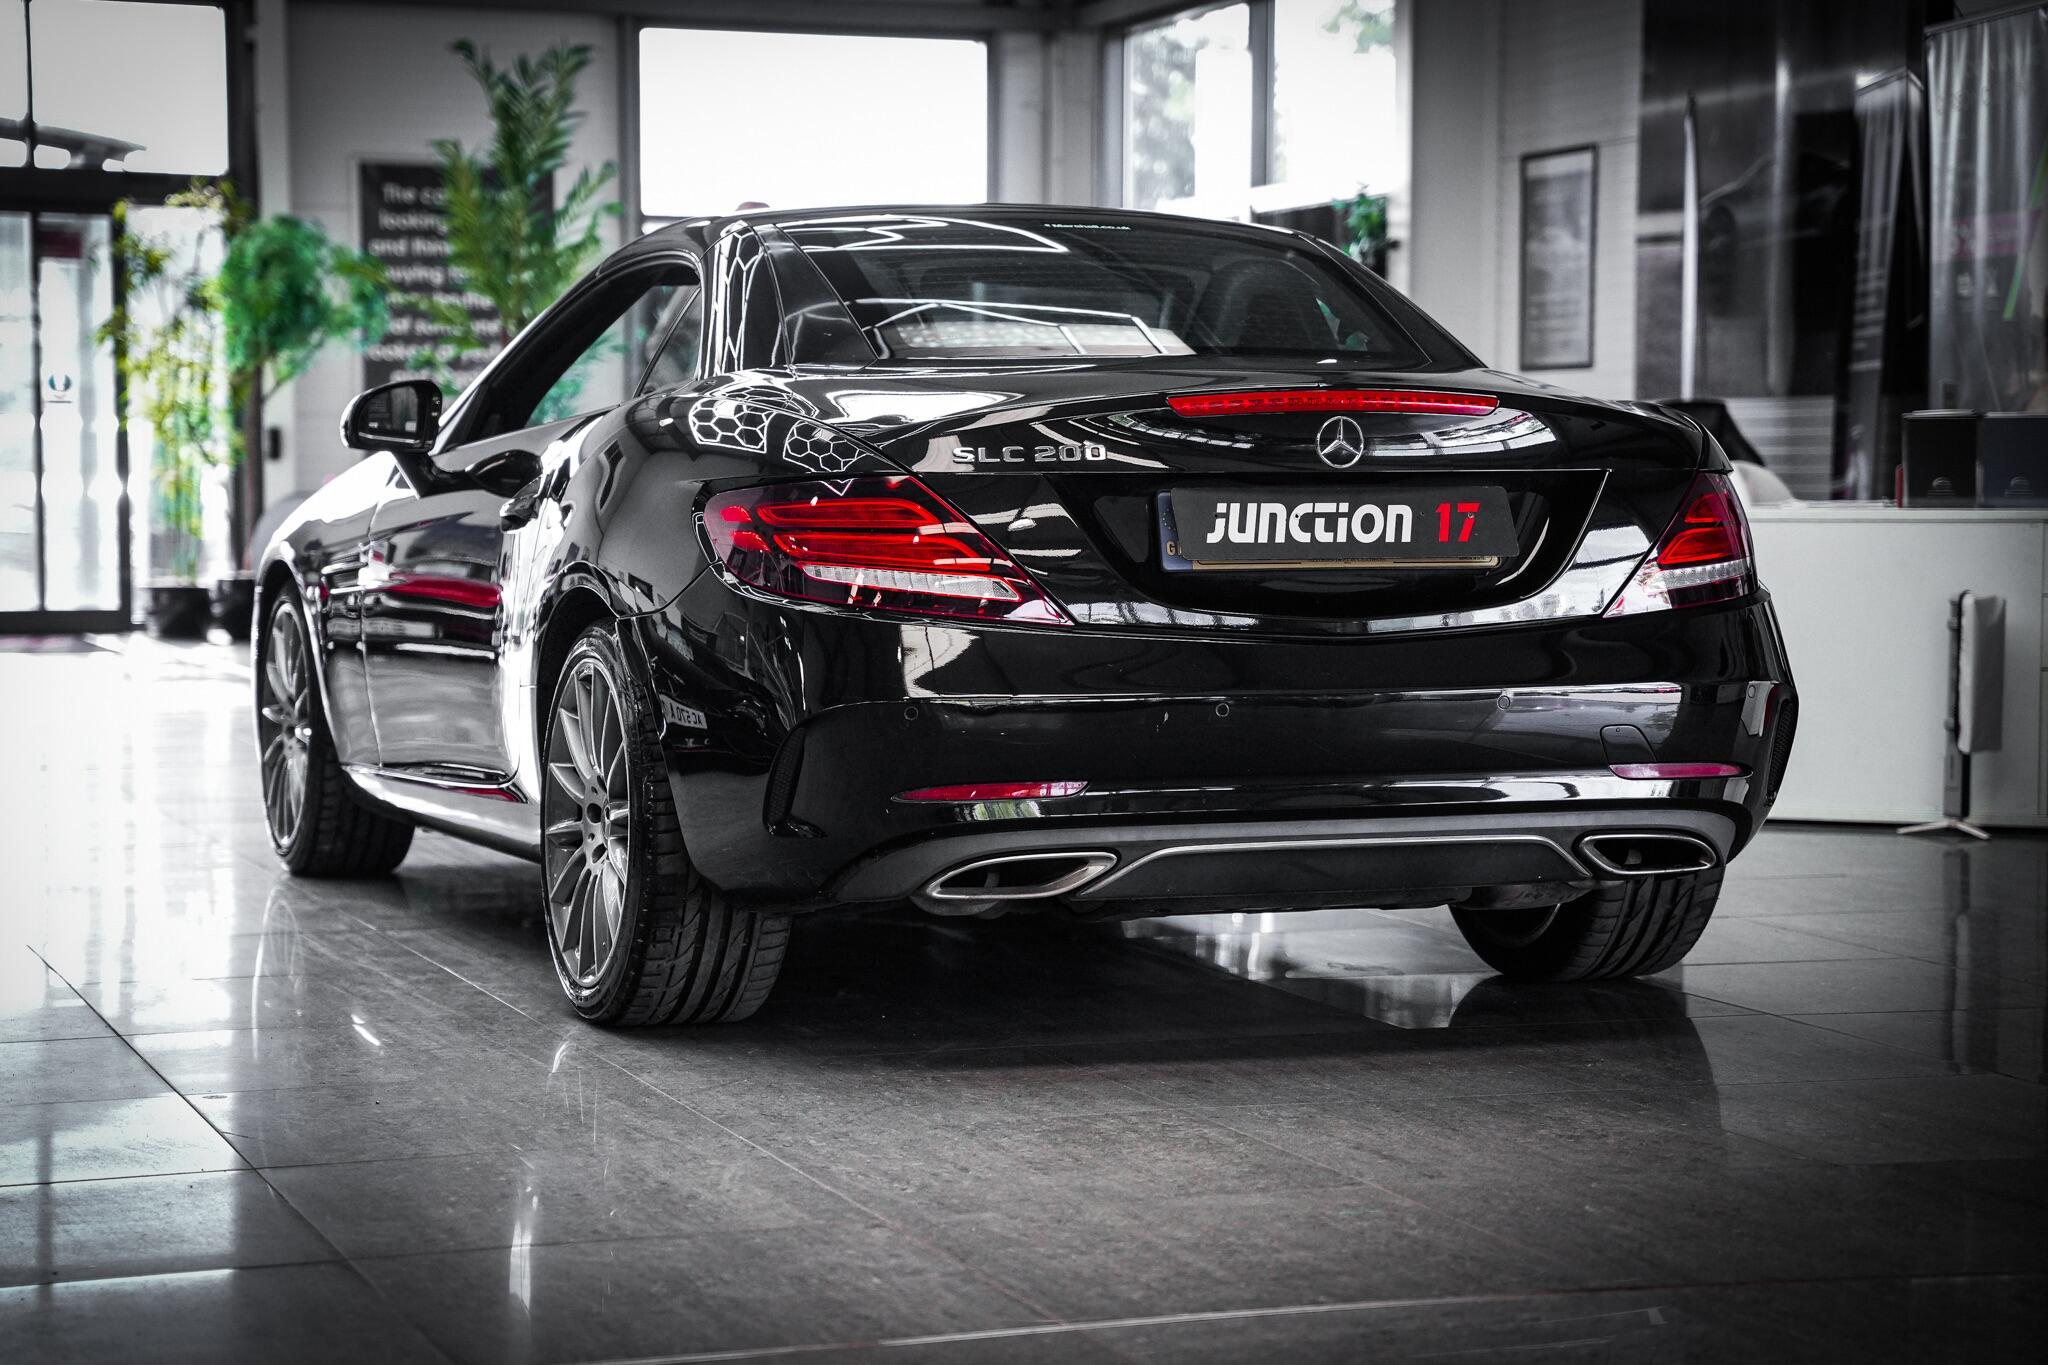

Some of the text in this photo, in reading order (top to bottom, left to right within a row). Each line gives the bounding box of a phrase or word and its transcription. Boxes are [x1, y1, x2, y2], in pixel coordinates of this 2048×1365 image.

[952, 445, 1107, 463] SLC 200
[1435, 502, 1481, 544] 17
